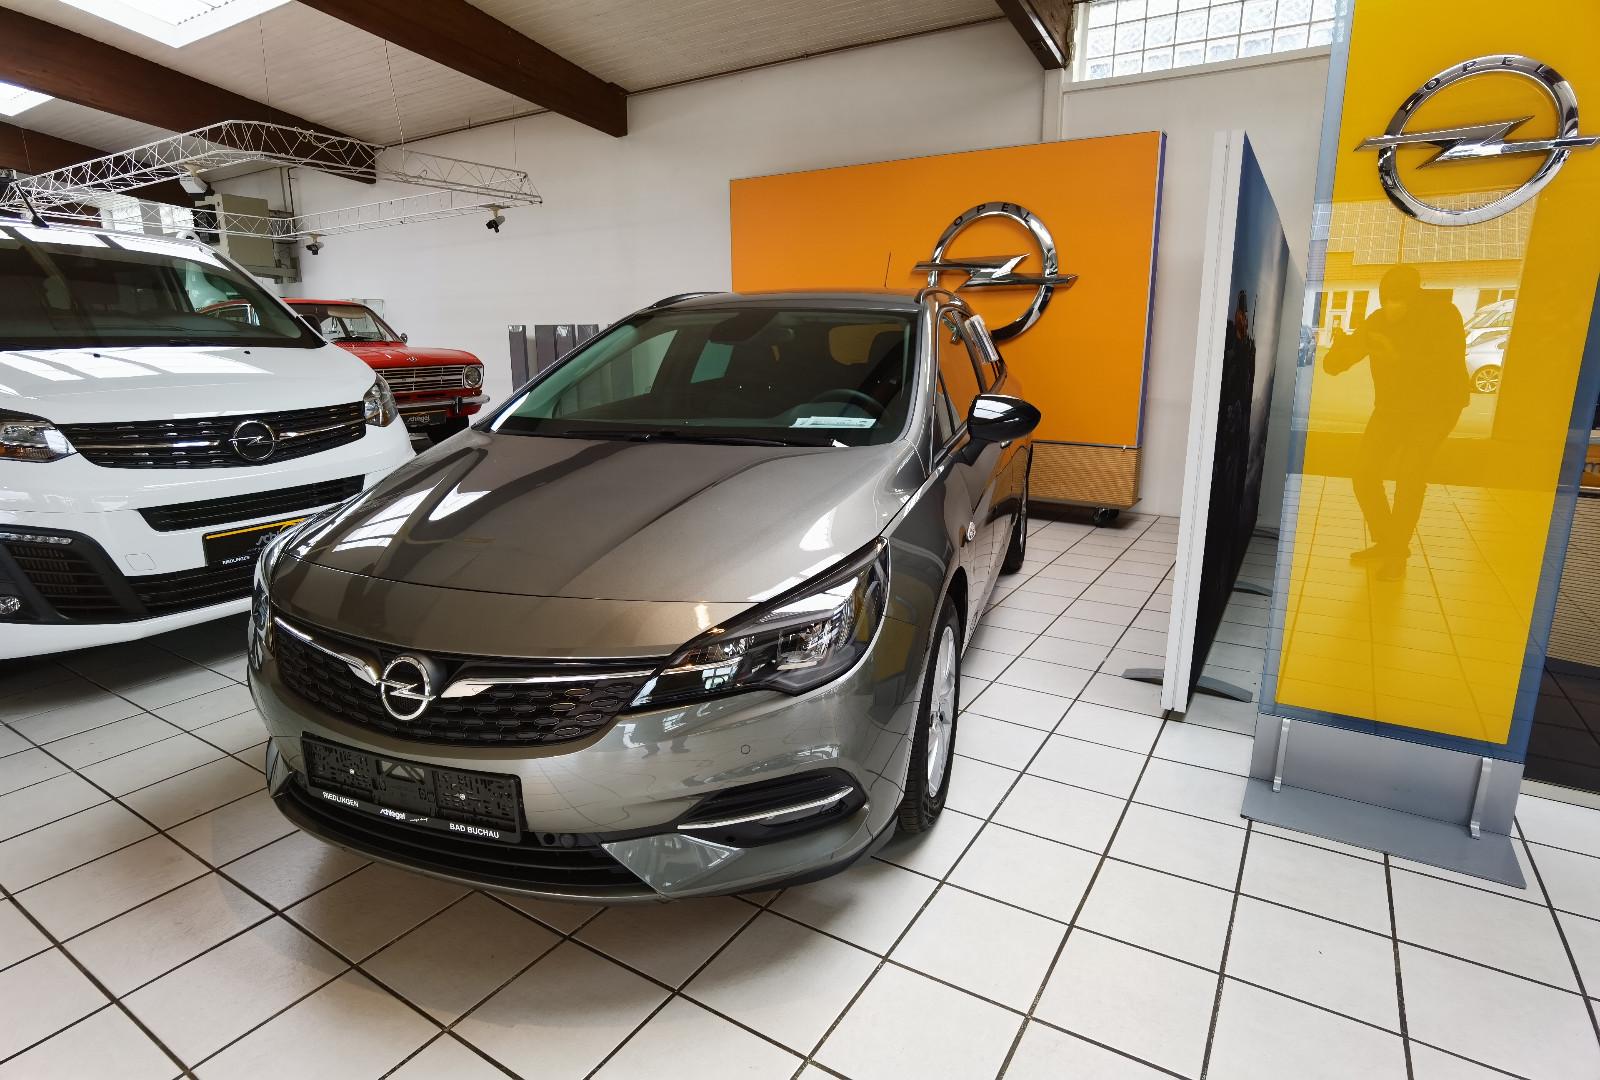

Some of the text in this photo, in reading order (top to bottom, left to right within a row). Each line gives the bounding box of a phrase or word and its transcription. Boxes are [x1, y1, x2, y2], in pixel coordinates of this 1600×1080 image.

[1423, 56, 1548, 91] OPEL
[953, 203, 1031, 227] OPEL
[449, 823, 500, 839] BAD BUCHAU
